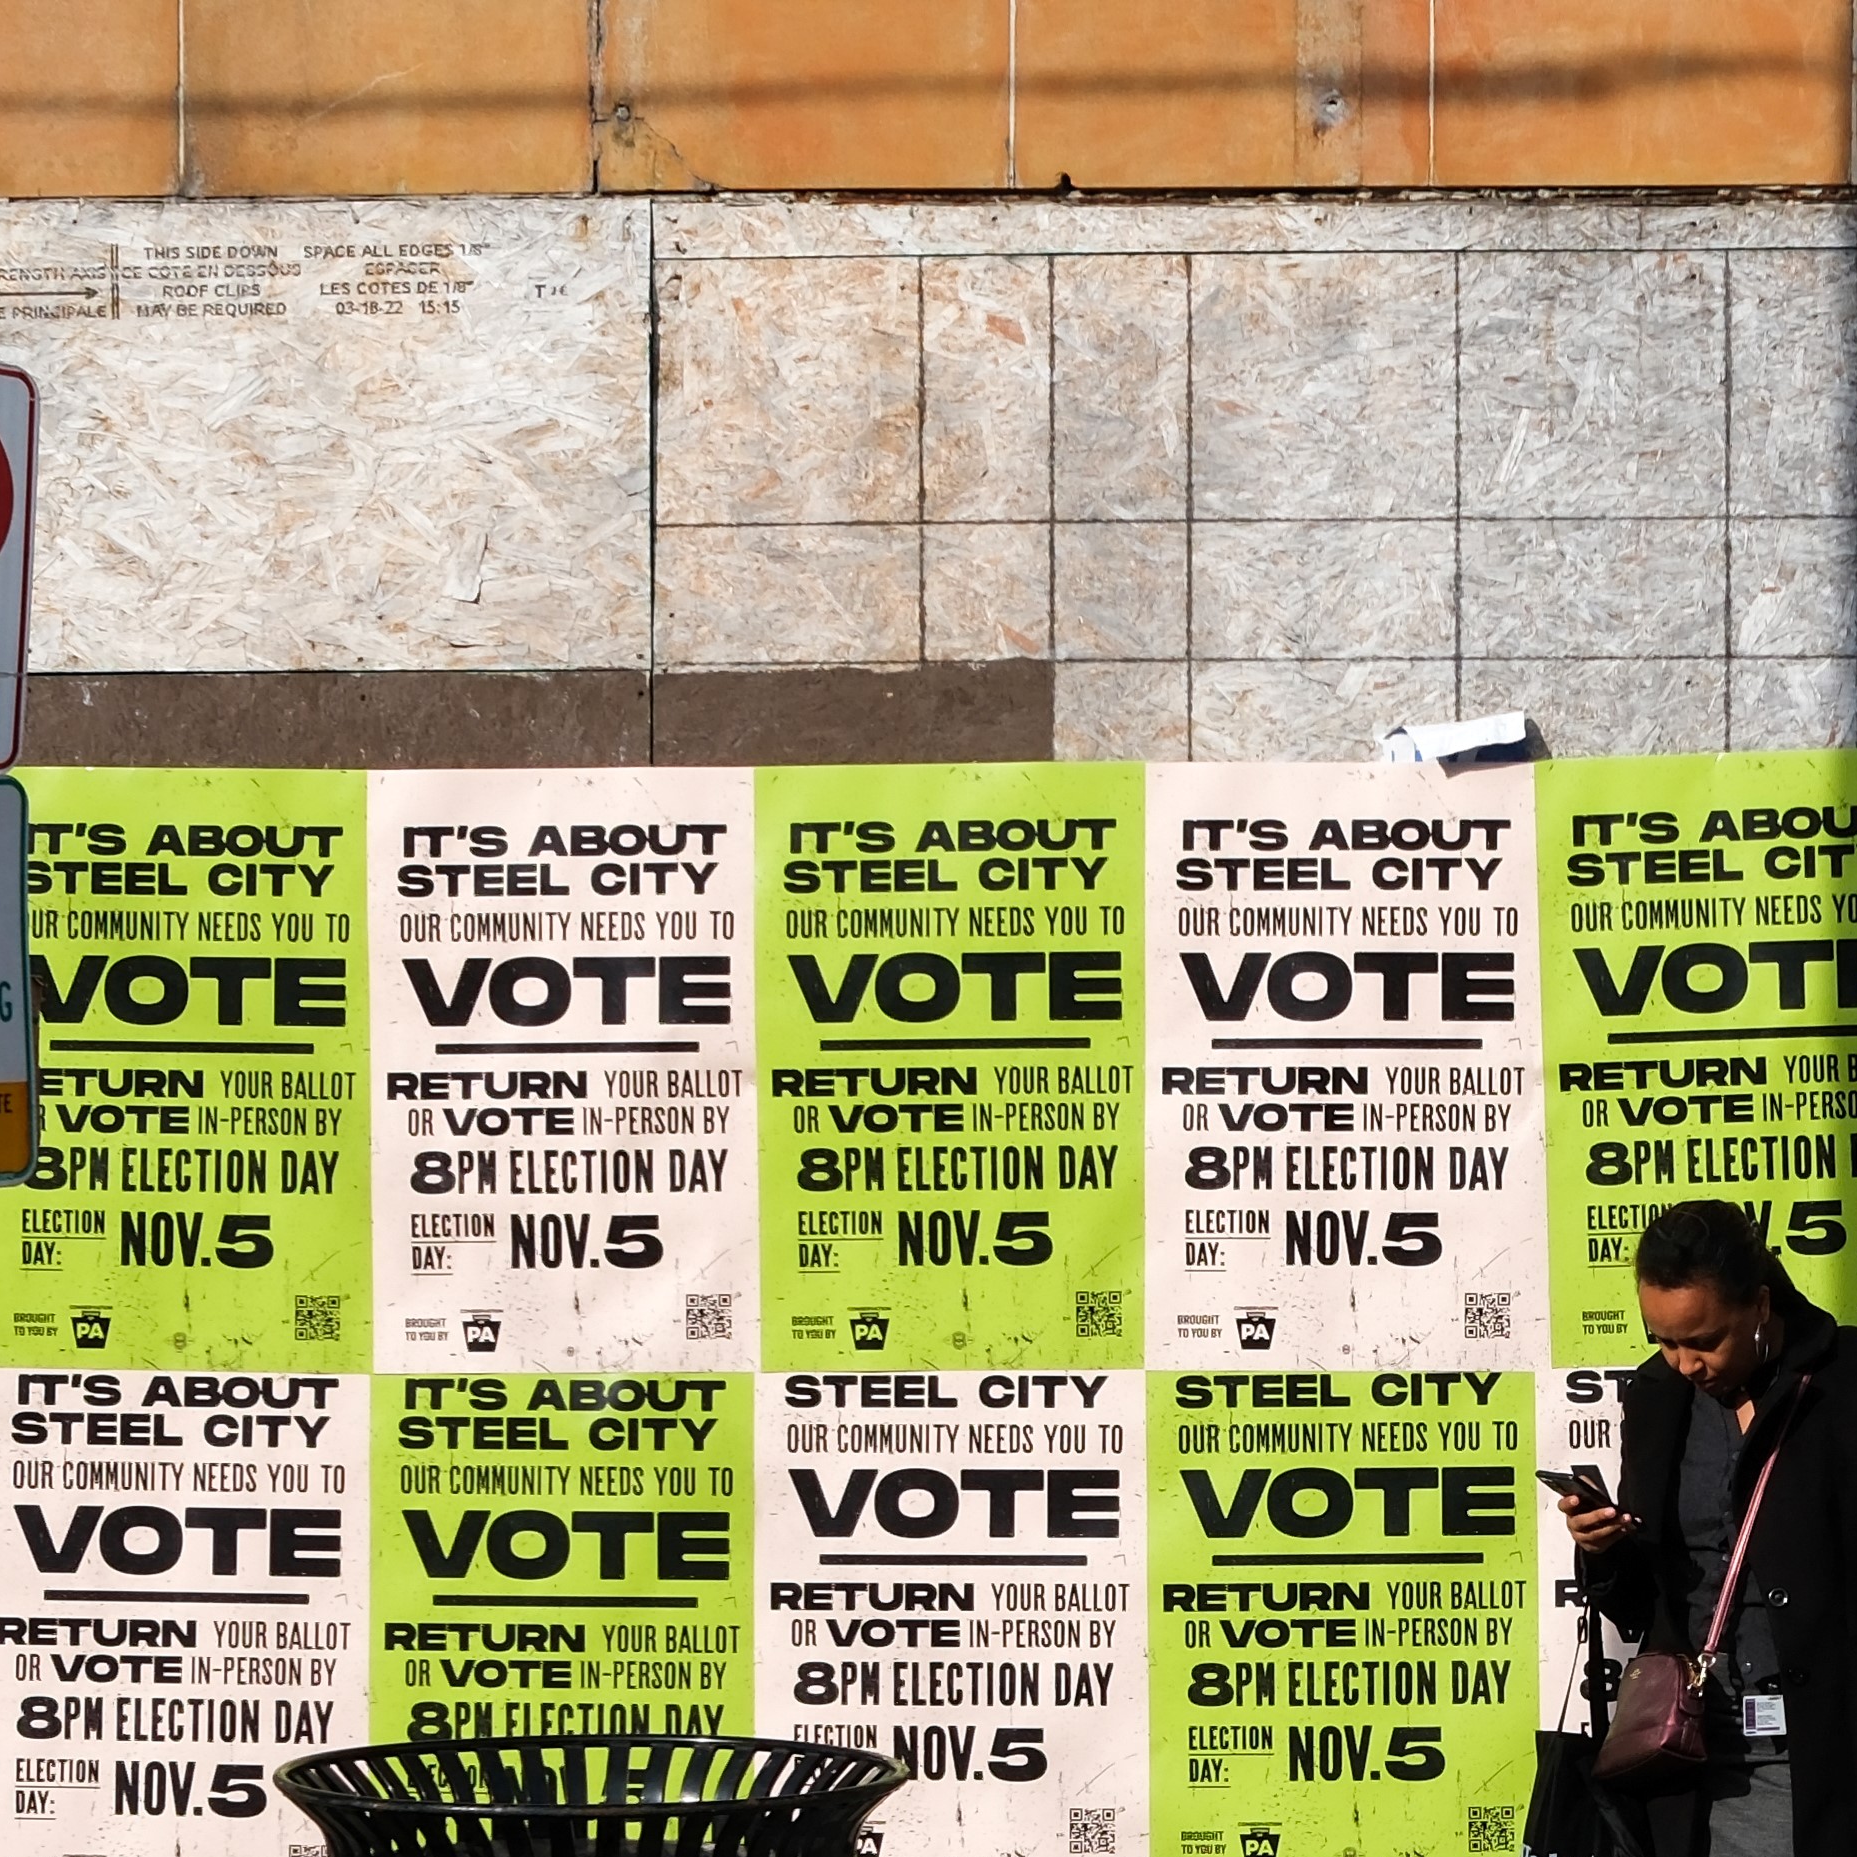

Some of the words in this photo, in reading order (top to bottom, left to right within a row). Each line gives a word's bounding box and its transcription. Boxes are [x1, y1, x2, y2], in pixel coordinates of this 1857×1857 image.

[144, 247, 180, 259] THIS
[186, 246, 221, 259] SIDE
[228, 246, 278, 258] DOWN
[304, 246, 355, 259] SPACE
[362, 245, 393, 257] ALL
[400, 244, 454, 257] EDGES
[71, 265, 106, 280] AXIS
[122, 266, 142, 279] CE
[198, 265, 218, 278] EN
[163, 285, 208, 297] ROOF
[215, 283, 260, 297] CLIPS
[320, 283, 350, 295] LES
[357, 282, 411, 295] COTES
[417, 281, 438, 294] DE
[13, 305, 107, 319] PRINCIPALE
[137, 304, 171, 317] MAY
[177, 304, 198, 317] BE
[204, 302, 287, 317] REQUIRED
[419, 300, 460, 314] 15:15
[790, 821, 895, 854] IT'S
[915, 819, 1116, 852] ABOUT
[1573, 812, 1679, 846] IT'S
[784, 859, 957, 893] STEEL
[979, 857, 1107, 891] CITY
[400, 914, 440, 942] OUR
[450, 912, 570, 942] COMMUNITY
[581, 912, 645, 941] NEEDS
[656, 911, 696, 940] YOU
[710, 911, 734, 940] TO
[402, 956, 731, 1026] VOTE
[1559, 1057, 1767, 1092] RETURN
[1784, 1055, 1839, 1083] YOUR
[1185, 1146, 1272, 1190] 8PM
[1287, 1146, 1433, 1190] ELECTION
[1450, 1147, 1508, 1190] DAY
[23, 1209, 105, 1234] ELECTION
[1186, 1210, 1269, 1233] ELECTION
[22, 1241, 63, 1265] DAY:
[121, 1211, 273, 1268] NOV.5
[1286, 1211, 1442, 1266] NOV.5
[1186, 1242, 1226, 1266] DAY:
[14, 1313, 55, 1323] BROUGHT
[15, 1326, 27, 1336] TO
[28, 1326, 45, 1336] YOU
[45, 1326, 58, 1336] BY
[854, 1325, 883, 1341] PA
[405, 1378, 507, 1410] IT'S
[527, 1380, 726, 1412] ABOUT
[785, 1375, 957, 1408] STEEL
[979, 1375, 1107, 1408] CITY
[12, 1412, 183, 1446] STEEL
[204, 1415, 330, 1448] CITY
[1179, 1424, 1220, 1454] OUR
[1229, 1423, 1352, 1453] COMMUNITY
[1362, 1422, 1427, 1452] NEEDS
[1438, 1422, 1480, 1451] YOU
[1492, 1421, 1517, 1450] TO
[1569, 1419, 1610, 1449] OUR
[788, 1468, 1119, 1538] VOTE
[14, 1505, 341, 1577] VOTE
[385, 1623, 585, 1652] RETURN
[602, 1625, 656, 1652] YOUR
[666, 1625, 740, 1653] BALLOT
[17, 1696, 103, 1740] 8PM
[117, 1697, 259, 1743] ELECTION
[276, 1700, 333, 1744] DAY
[1289, 1725, 1445, 1781] NOV.5
